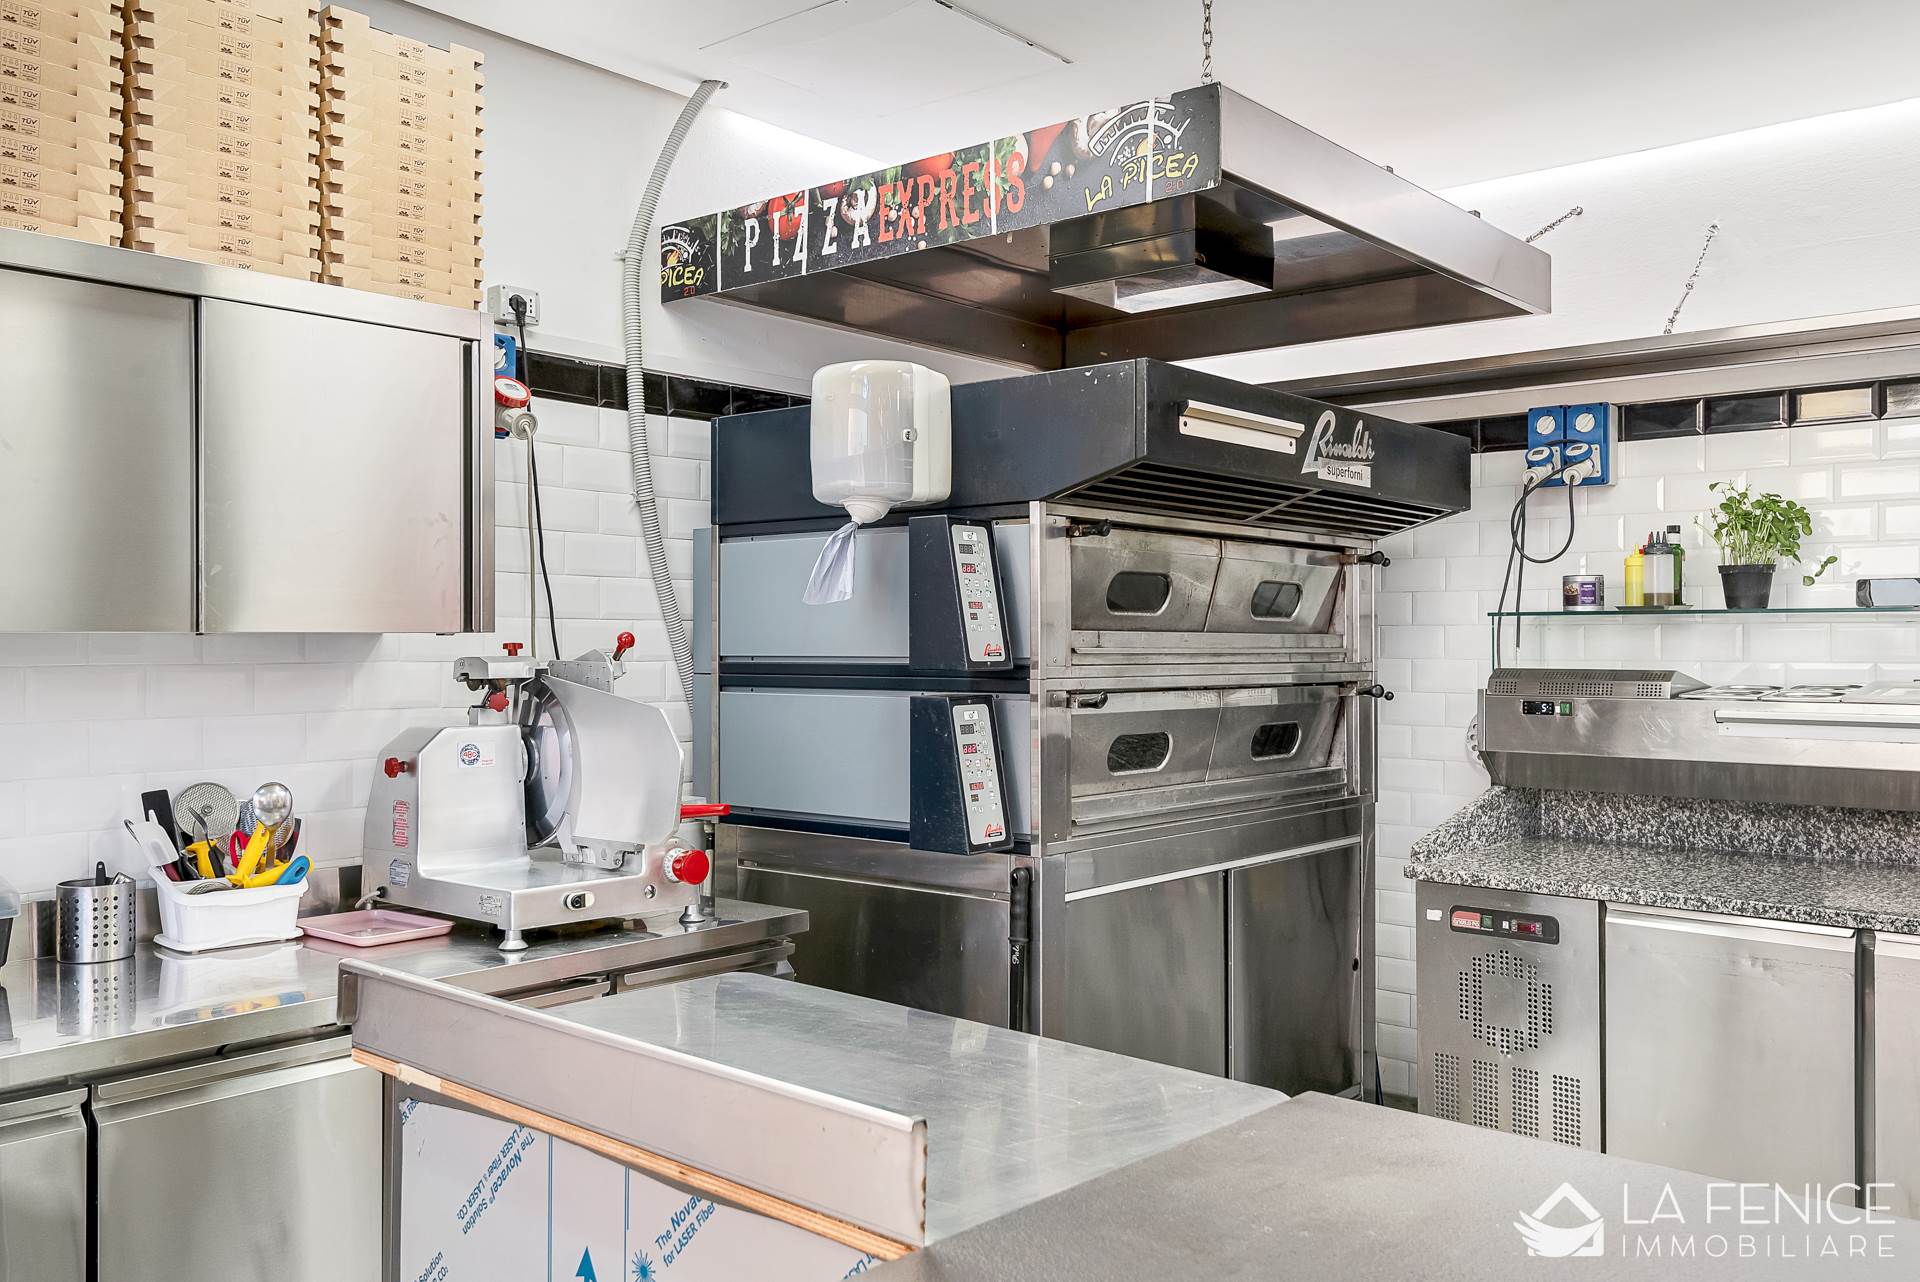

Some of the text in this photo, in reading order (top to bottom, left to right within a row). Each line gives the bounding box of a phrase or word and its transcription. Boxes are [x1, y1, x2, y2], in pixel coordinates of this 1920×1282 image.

[878, 151, 1025, 243] EXPRESS
[1084, 152, 1199, 212] LA PICEA
[1301, 410, 1376, 474] Rinaldi
[1326, 464, 1363, 481] superforni
[500, 1129, 520, 1158] LASER
[487, 1154, 502, 1178] Fiber
[467, 1179, 485, 1208] LASER
[462, 1198, 488, 1234] Solution
[654, 1229, 672, 1250] The
[663, 1249, 675, 1267] for
[673, 1222, 698, 1255] LASER
